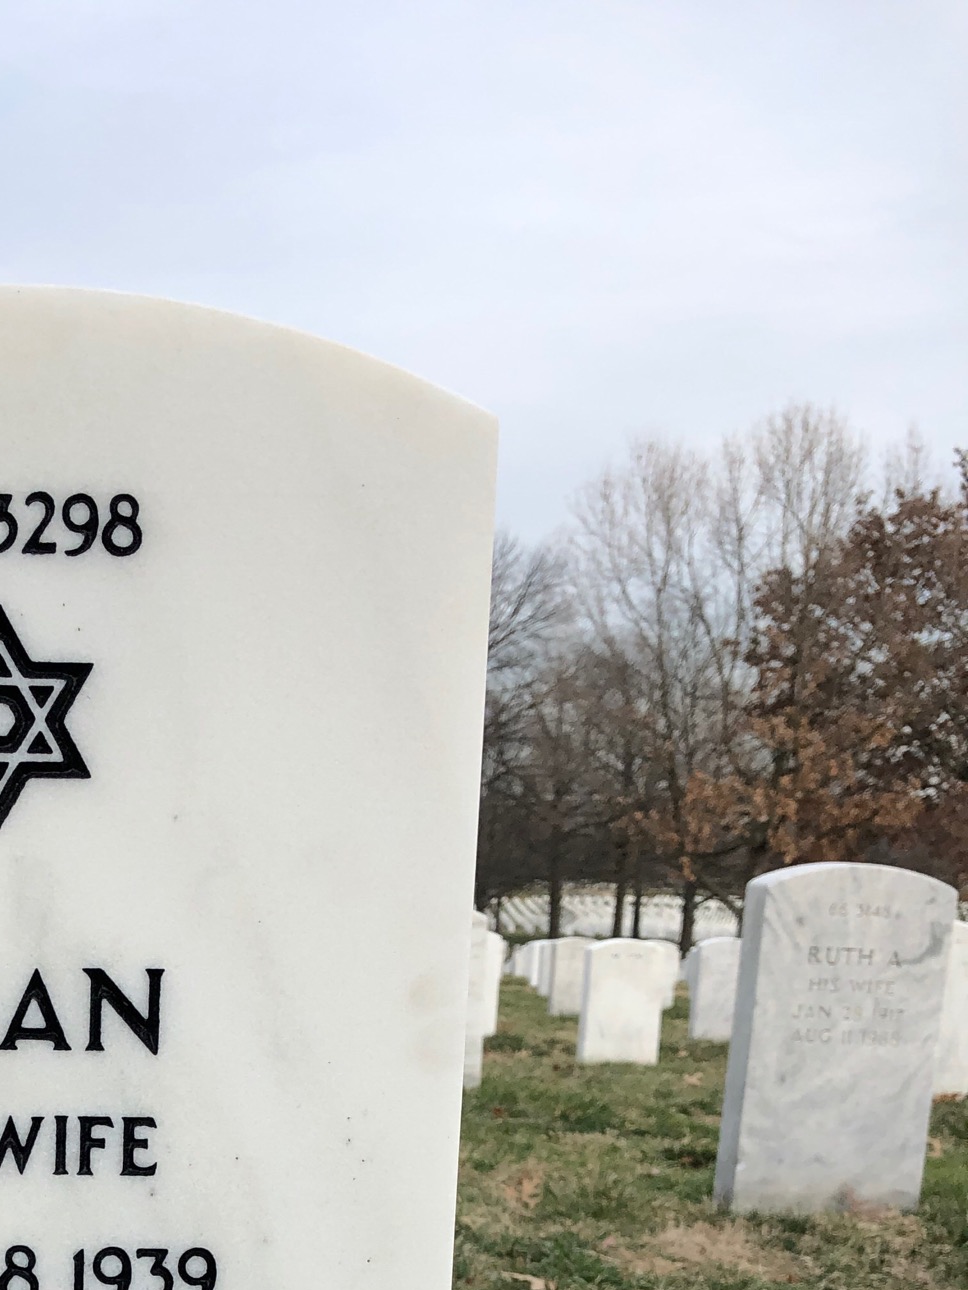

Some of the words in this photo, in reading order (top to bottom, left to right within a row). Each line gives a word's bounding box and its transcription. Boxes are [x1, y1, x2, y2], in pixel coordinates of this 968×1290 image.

[807, 945, 874, 966] RUTH
[887, 950, 902, 967] A
[808, 977, 840, 993] HIS
[849, 979, 896, 996] WIFE
[791, 1003, 832, 1019] JAN
[790, 1028, 832, 1044] AUG
